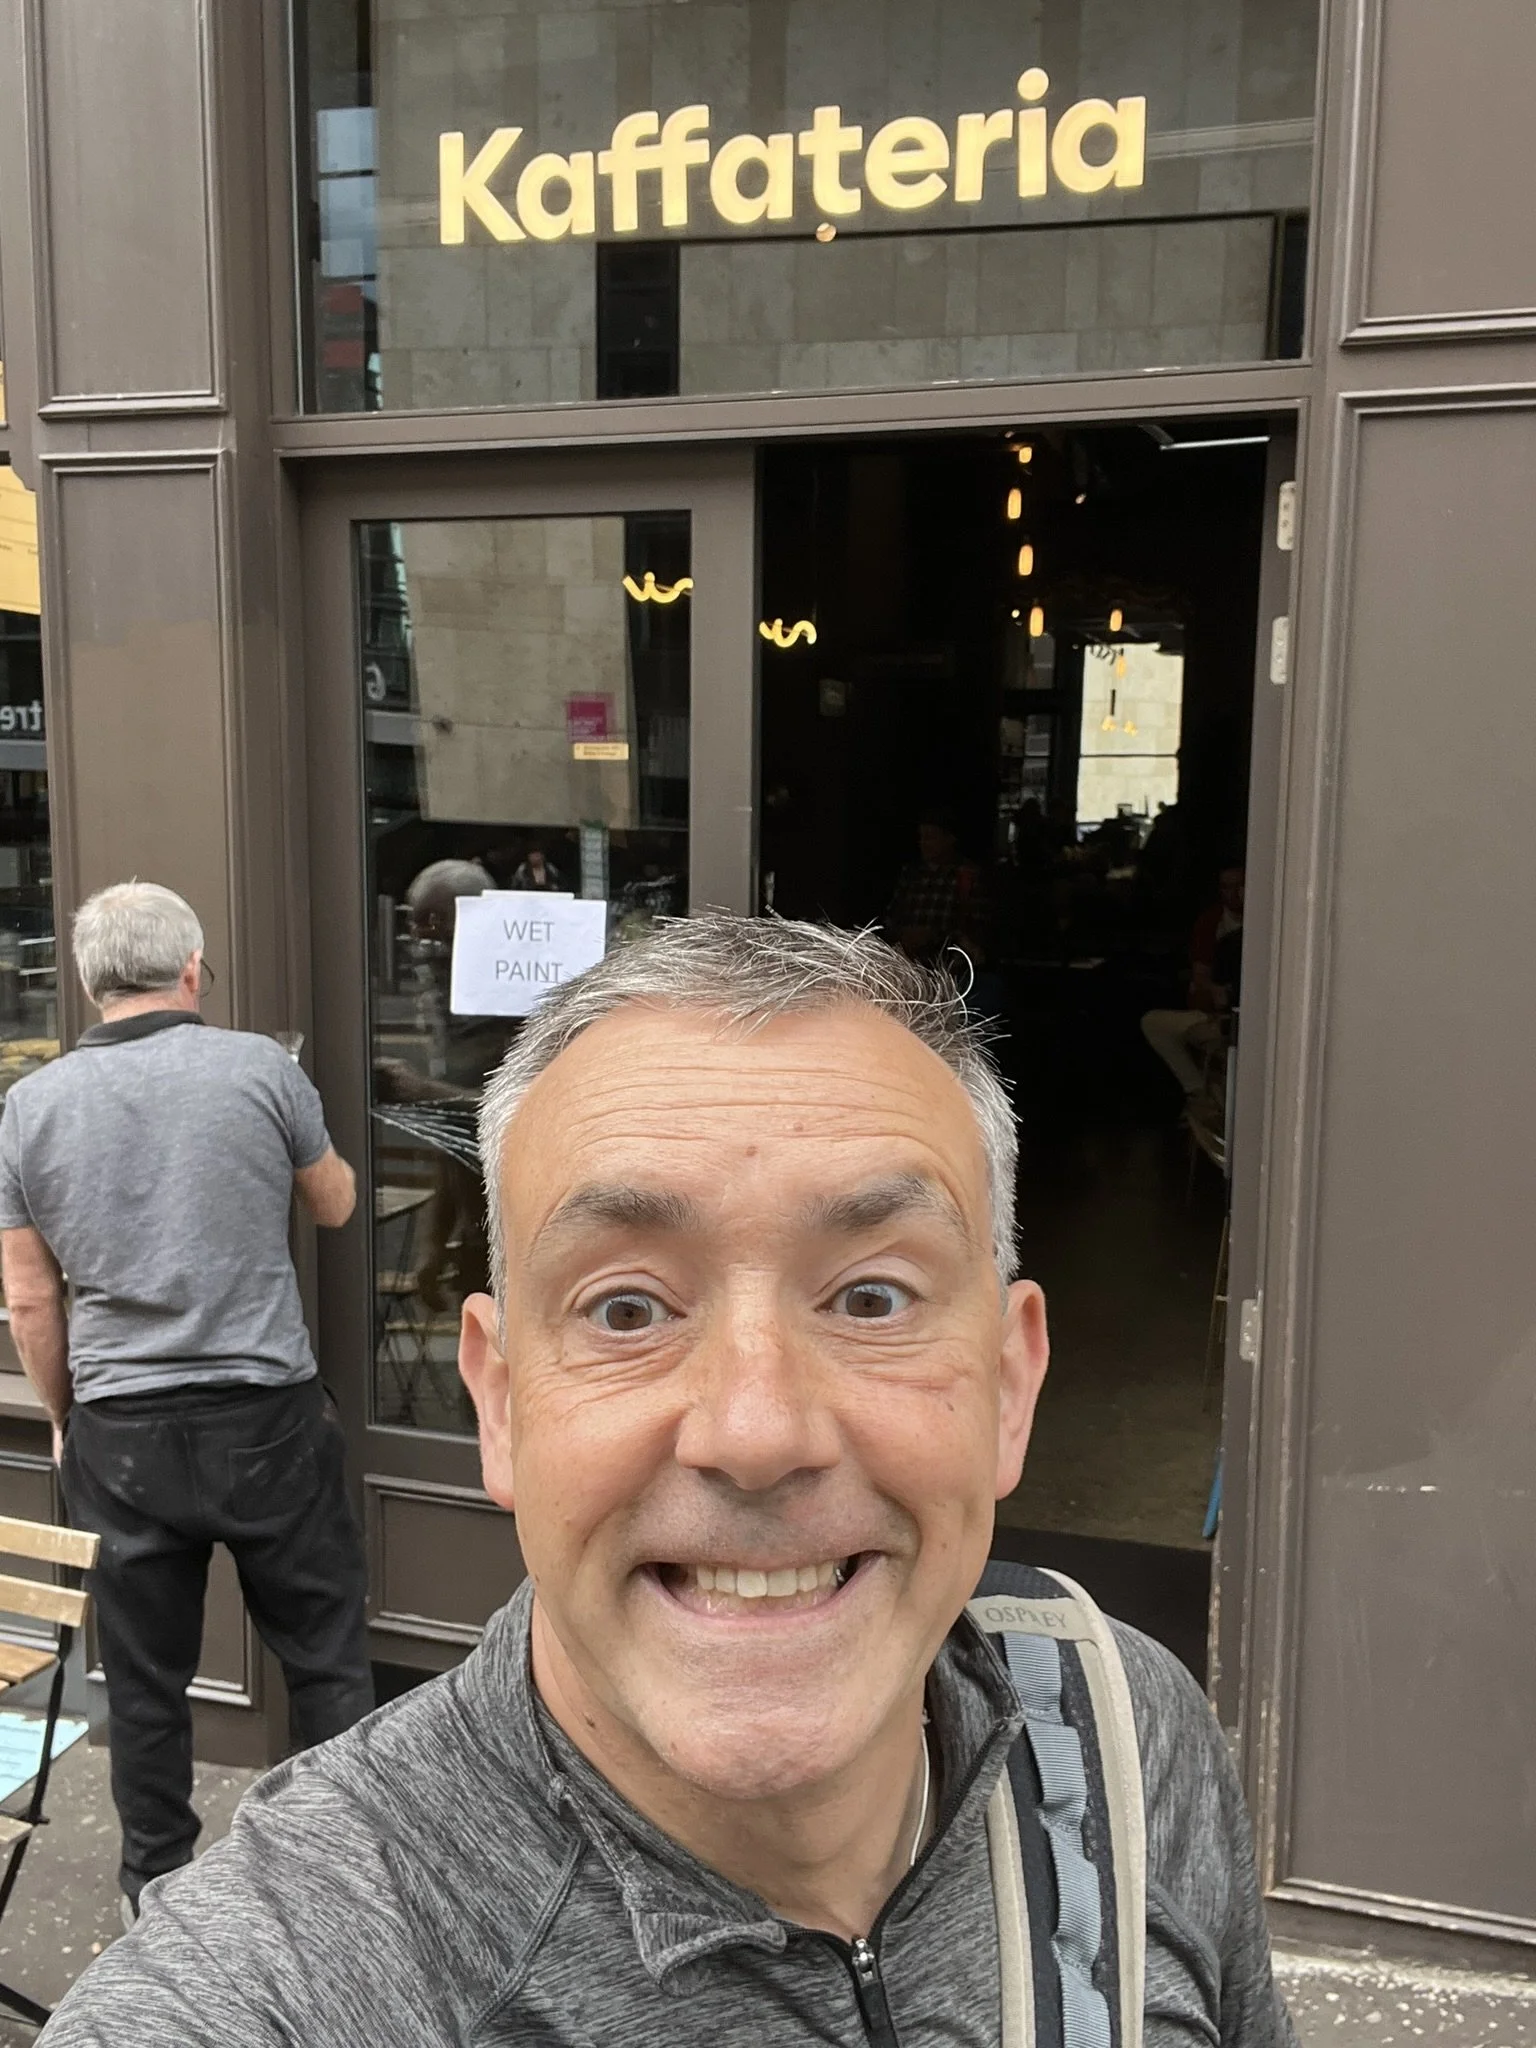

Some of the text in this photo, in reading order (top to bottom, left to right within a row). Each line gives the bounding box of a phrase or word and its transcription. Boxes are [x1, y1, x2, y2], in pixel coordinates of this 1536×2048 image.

[439, 67, 1146, 245] Kaffateria
[503, 919, 555, 942] WET
[495, 960, 563, 984] PAINT
[985, 1606, 1067, 1628] OSPREY
